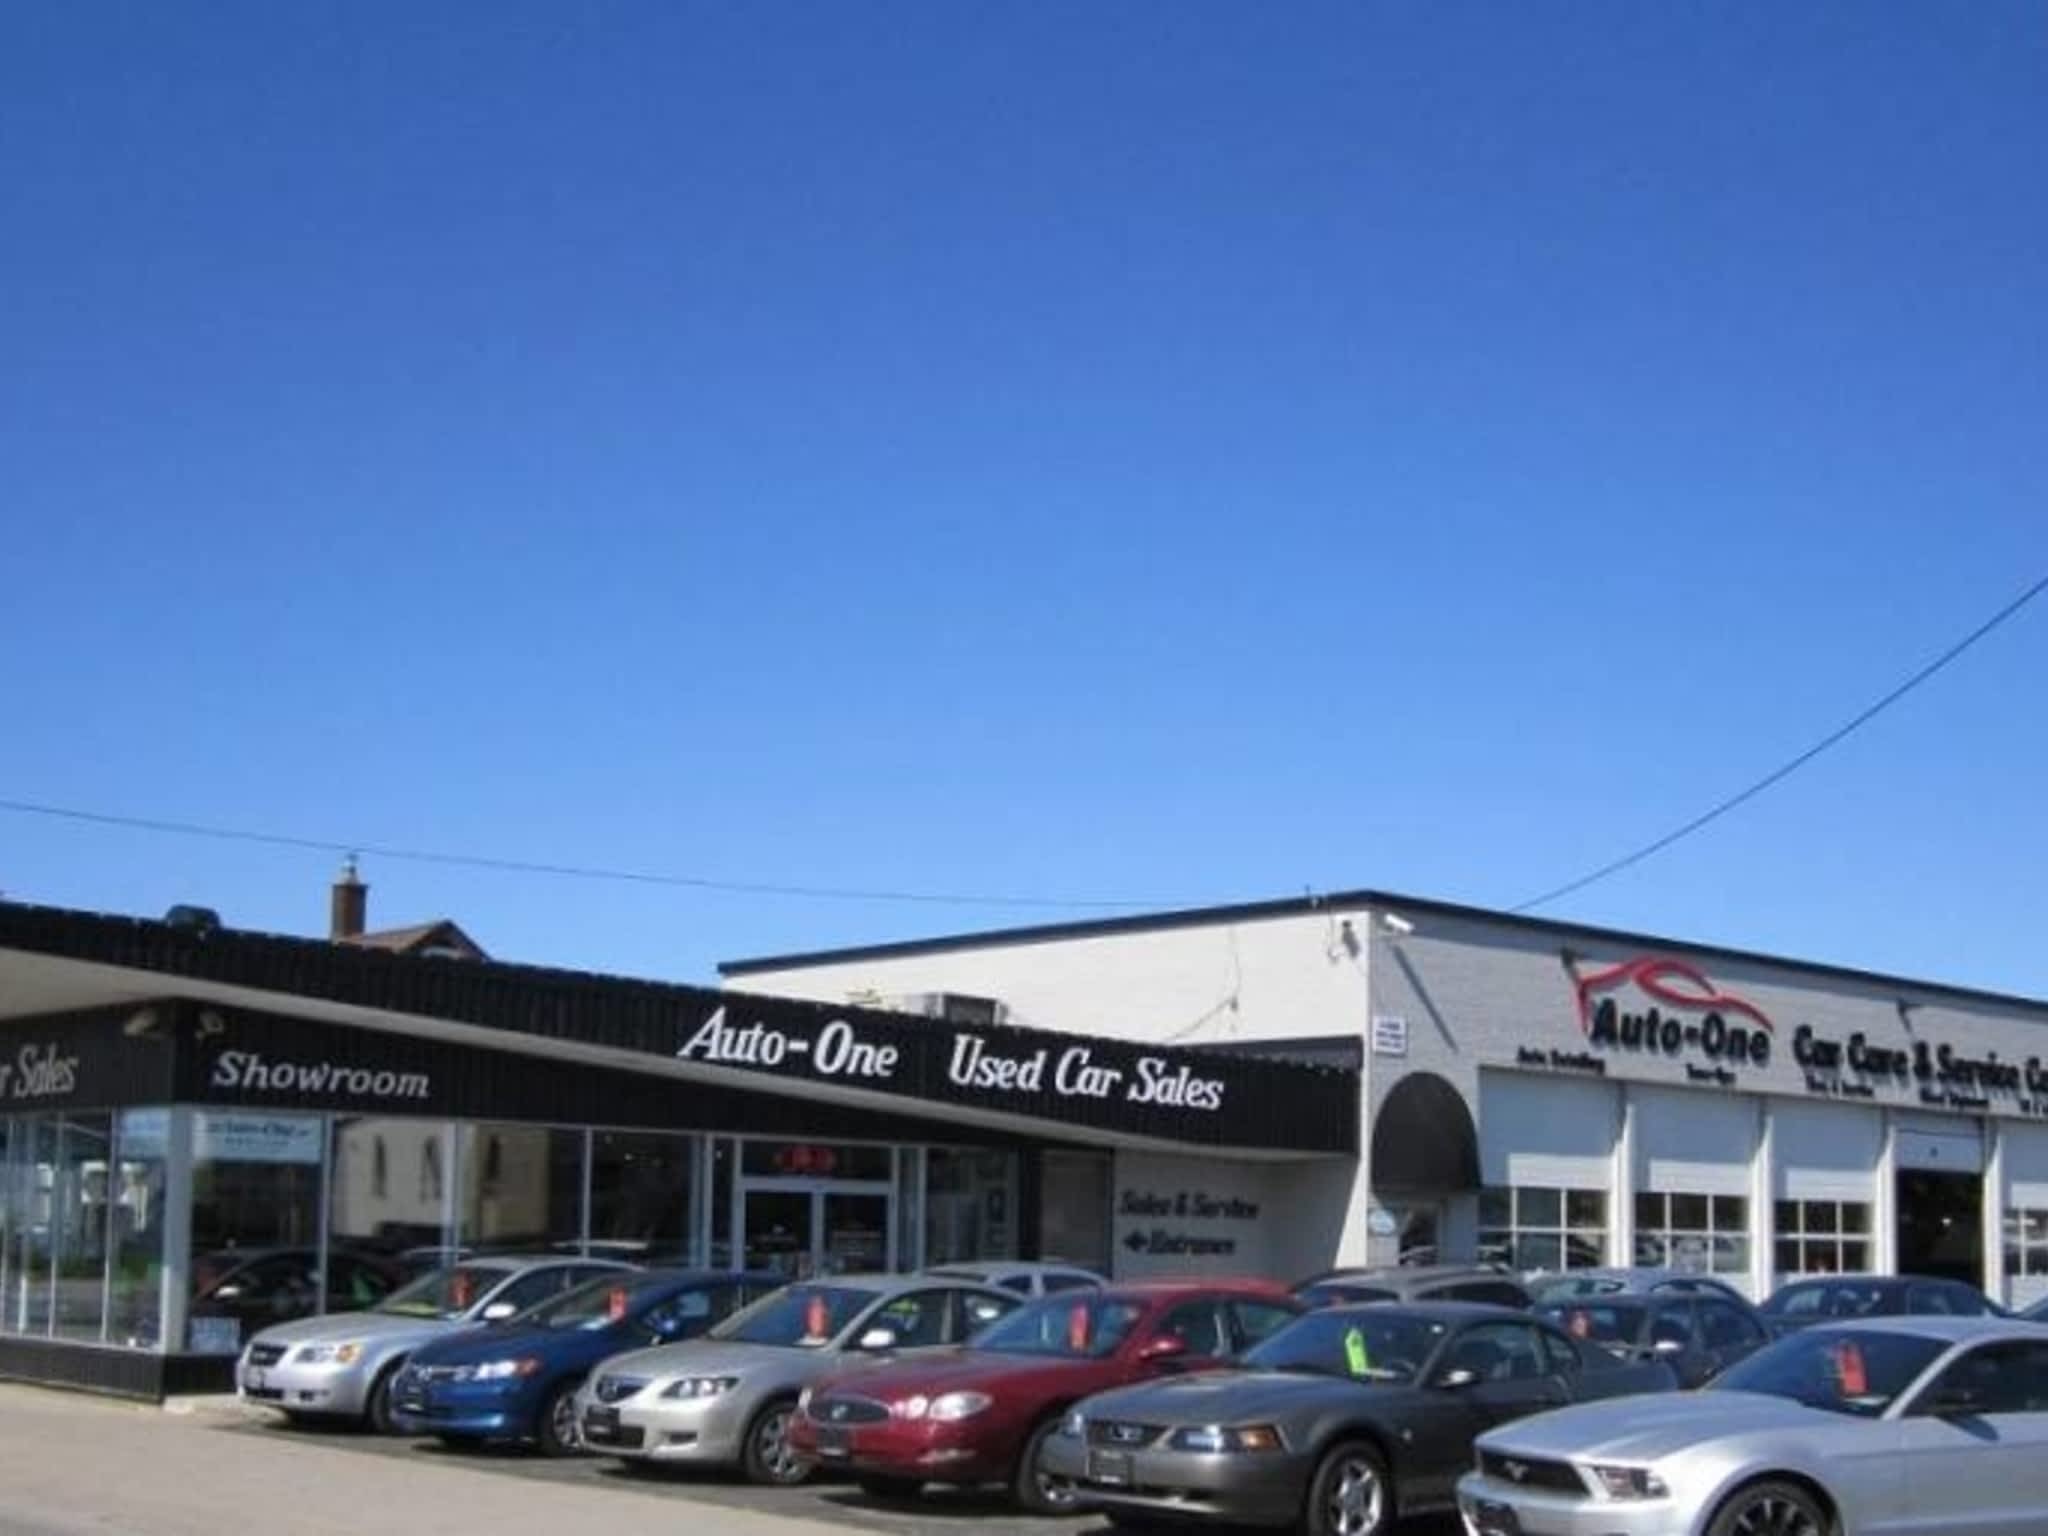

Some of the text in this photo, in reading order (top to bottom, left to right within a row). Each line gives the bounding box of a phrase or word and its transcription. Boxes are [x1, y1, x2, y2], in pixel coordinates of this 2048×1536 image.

[14, 1043, 79, 1098] Sales
[213, 1050, 430, 1099] Showroom
[678, 1006, 1224, 1110] Auto-One Used Car Sales
[1590, 998, 1770, 1064] Auto-One
[1794, 1025, 1841, 1067] Car
[1937, 1044, 2020, 1088] Service
